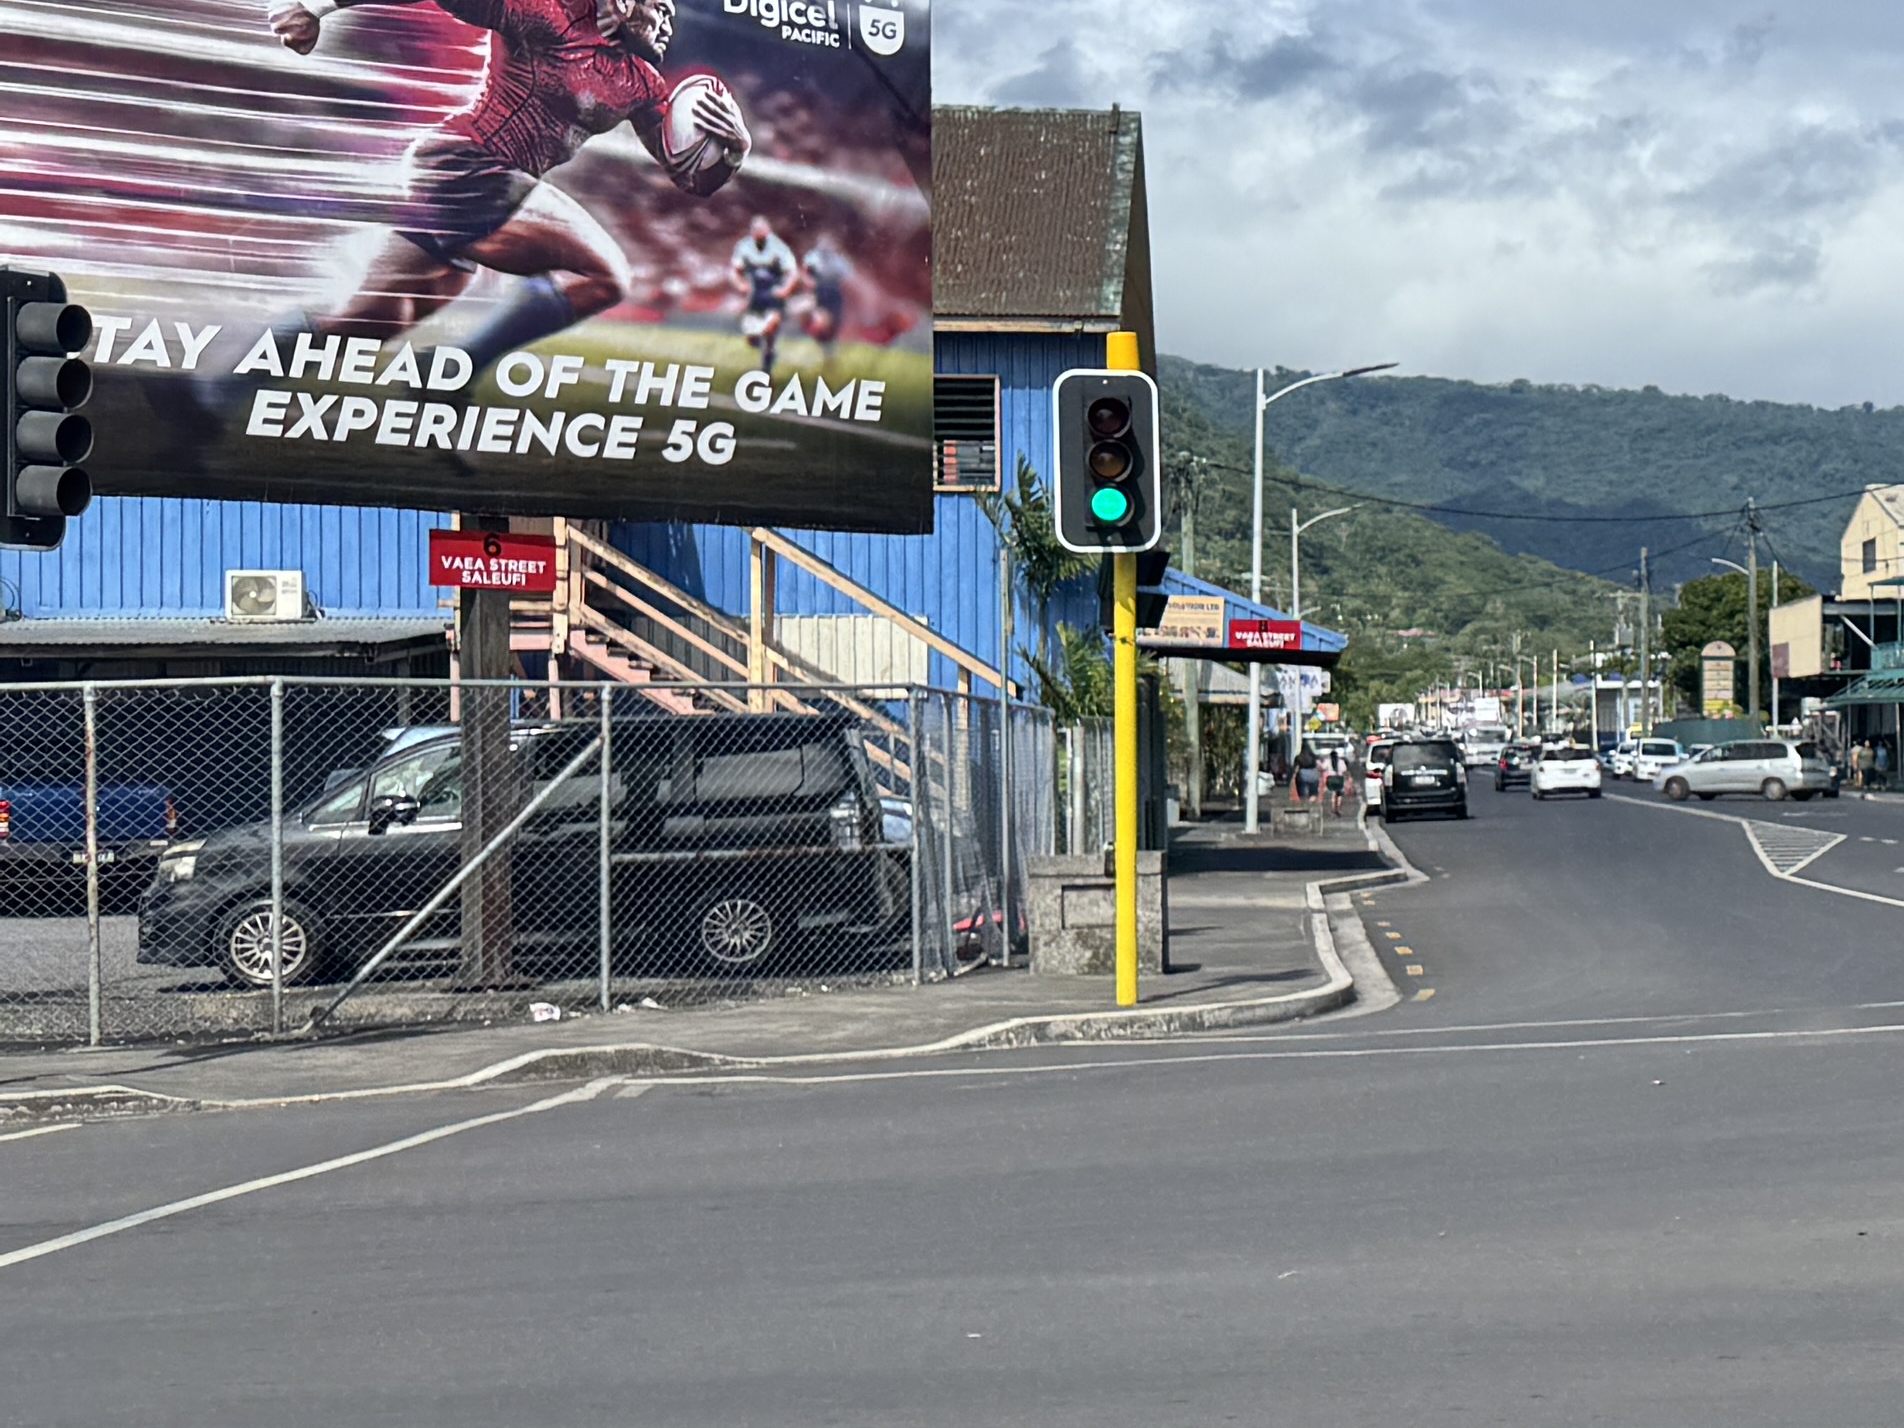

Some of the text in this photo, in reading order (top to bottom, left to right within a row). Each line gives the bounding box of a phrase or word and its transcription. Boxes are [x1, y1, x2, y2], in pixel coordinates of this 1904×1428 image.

[781, 25, 840, 48] PACIFIC
[868, 18, 897, 40] 5G
[67, 314, 886, 421] TAY AHEAD OF THE GAME
[245, 388, 737, 465] EXPERIENCE 5G
[483, 533, 501, 557] 6
[441, 555, 546, 574] VAEA STREET
[462, 570, 526, 586] SALEUFI
